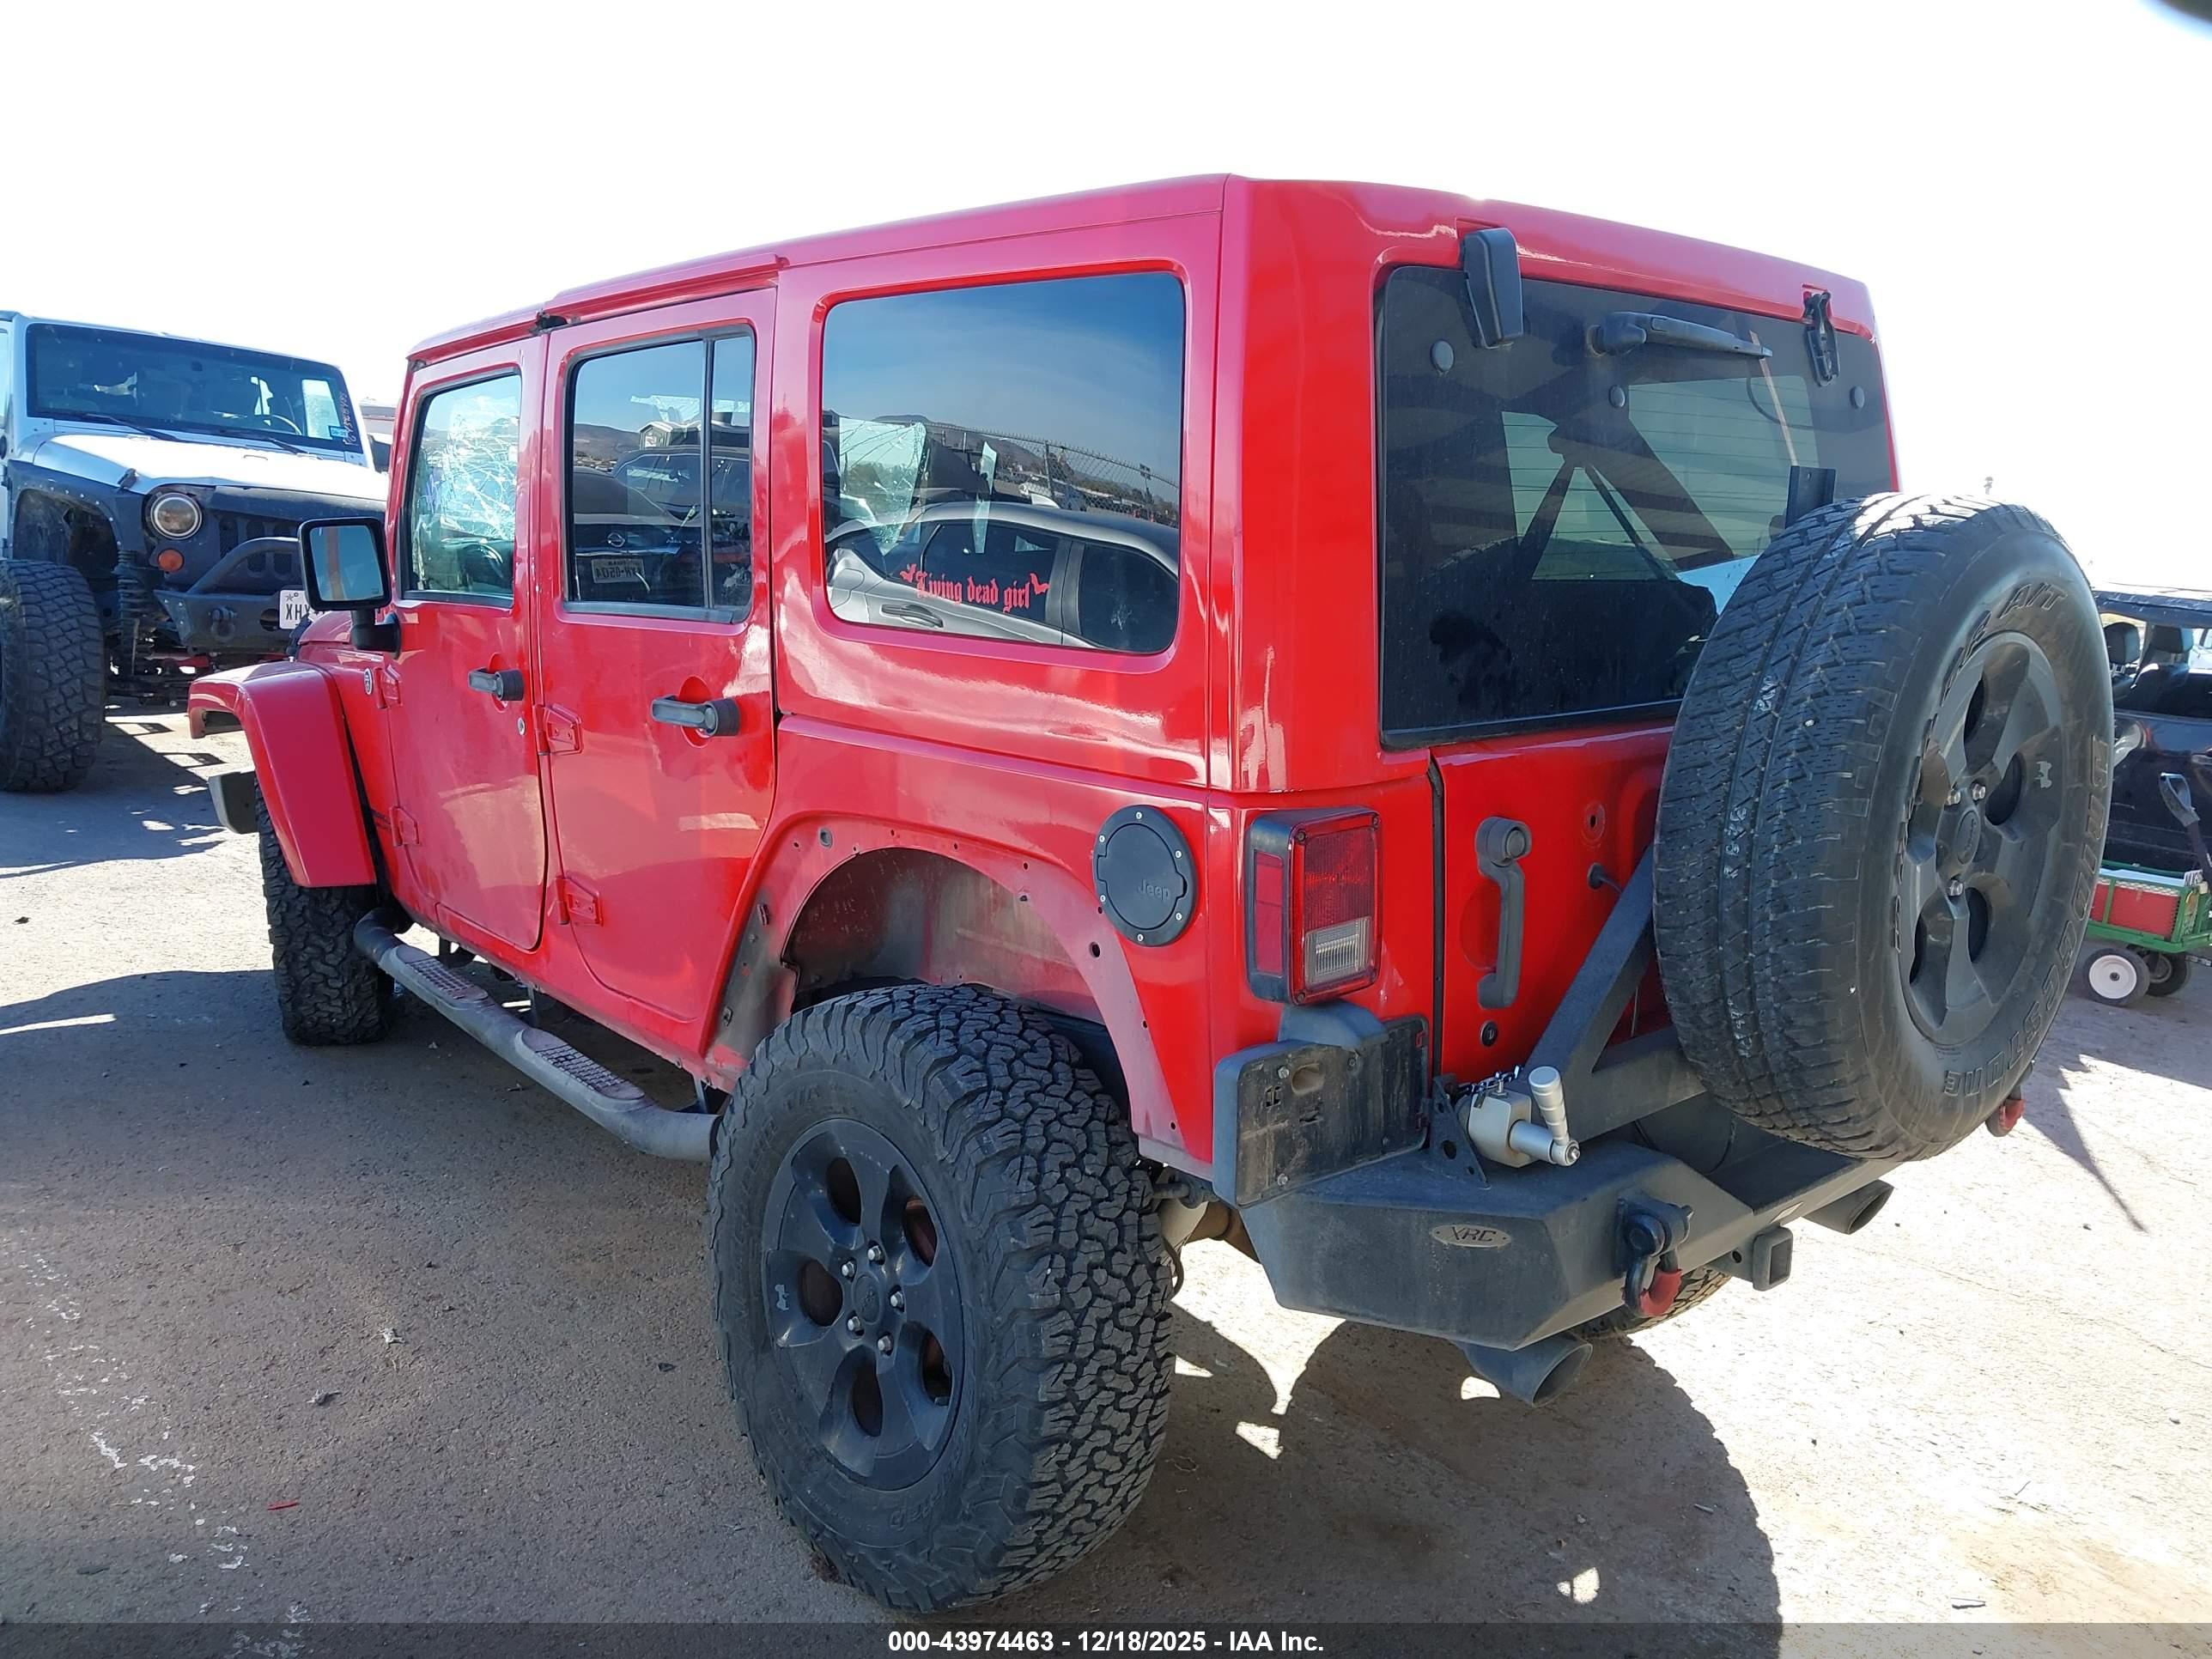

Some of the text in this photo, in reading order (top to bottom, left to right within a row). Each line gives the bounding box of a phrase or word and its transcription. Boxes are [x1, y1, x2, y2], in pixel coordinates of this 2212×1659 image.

[915, 570, 1030, 614] Living dead girl
[1997, 581, 2069, 618] A/T
[1138, 878, 1170, 902] Jeep
[1944, 733, 2109, 1097] BRIDGESTONE
[1449, 1226, 1497, 1242] XRC
